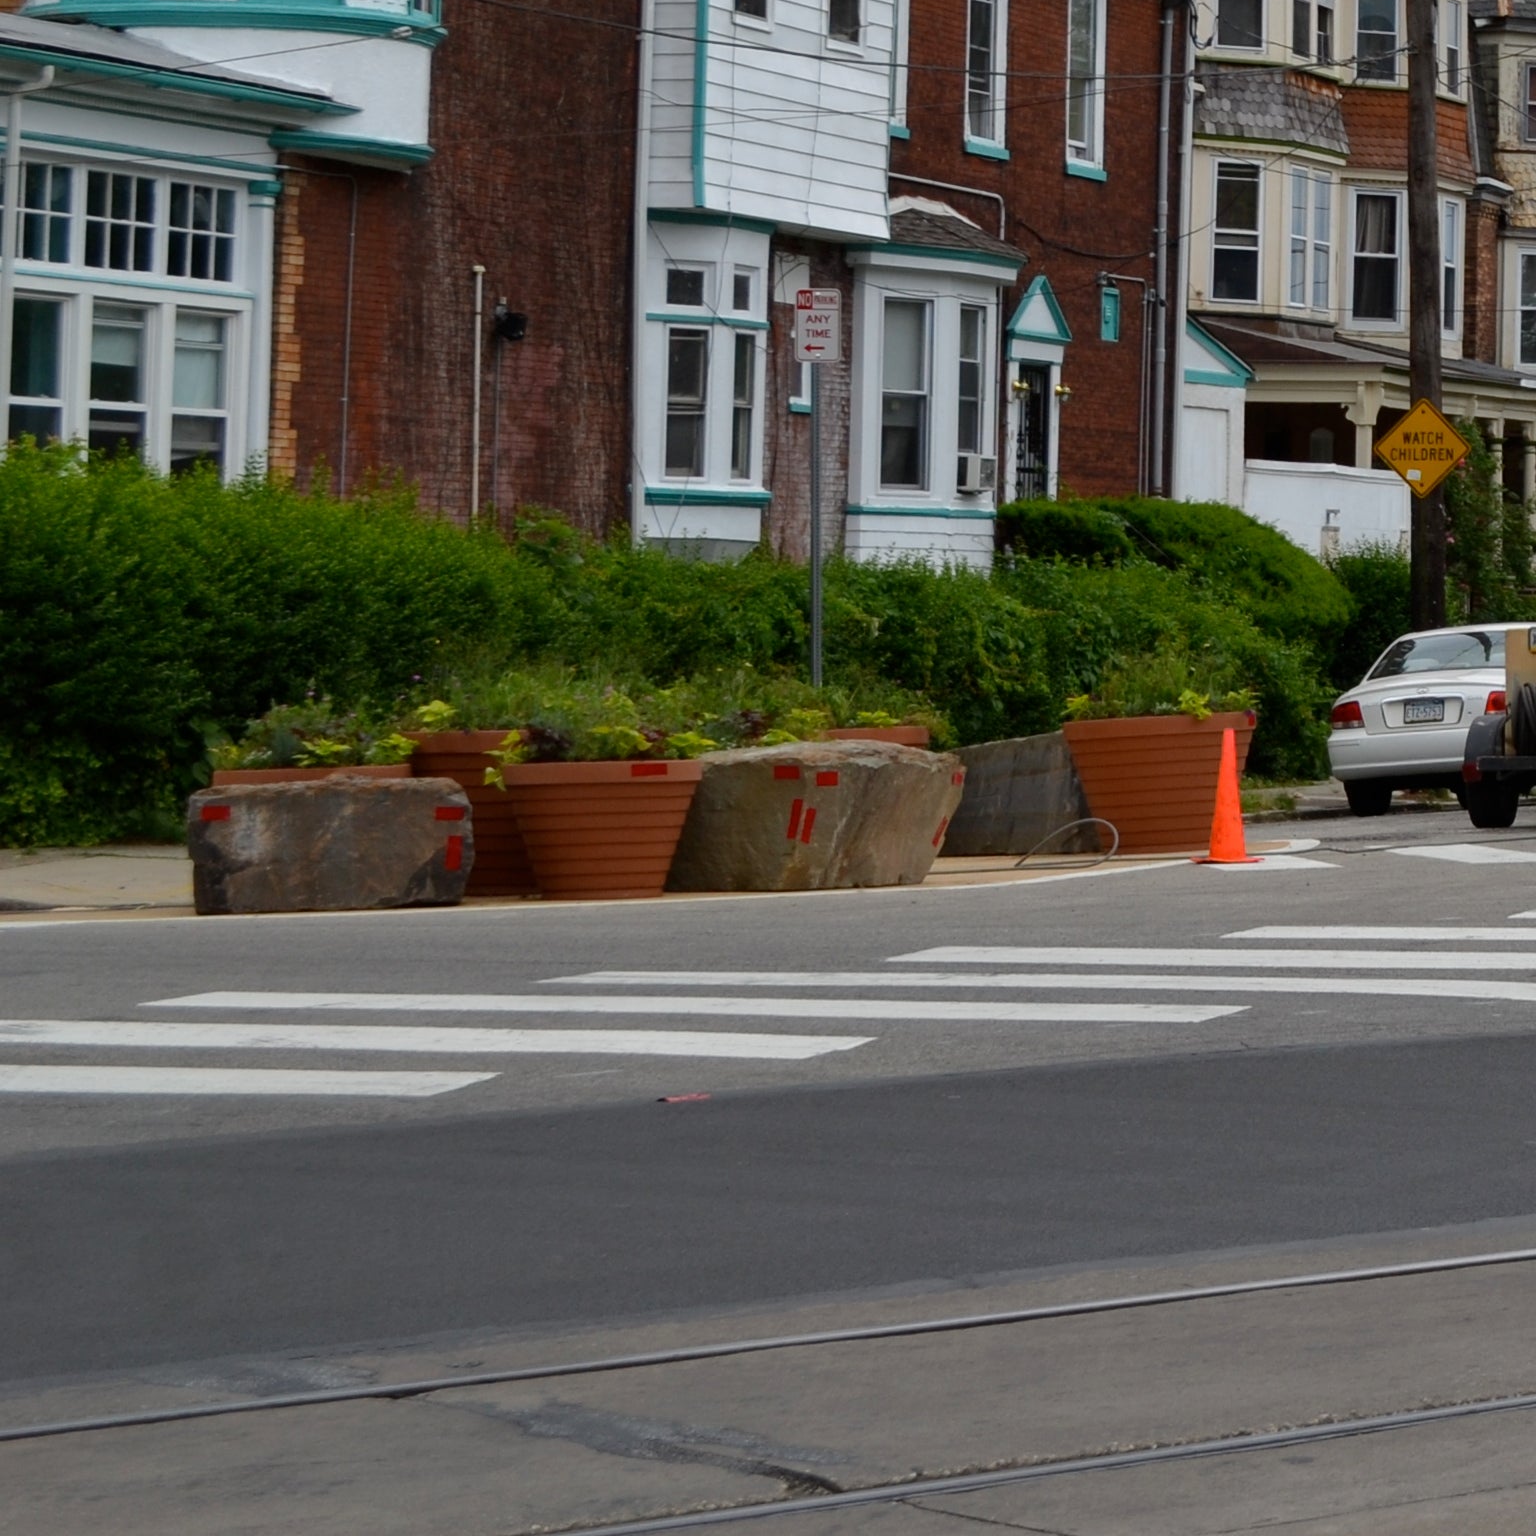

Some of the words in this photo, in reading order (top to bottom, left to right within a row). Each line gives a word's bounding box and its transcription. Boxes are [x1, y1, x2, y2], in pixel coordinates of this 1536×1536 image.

[797, 293, 812, 307] NO
[806, 314, 831, 324] ANY
[806, 329, 832, 339] TIME
[1403, 432, 1444, 445] WATCH
[1390, 448, 1454, 462] CHILDREN
